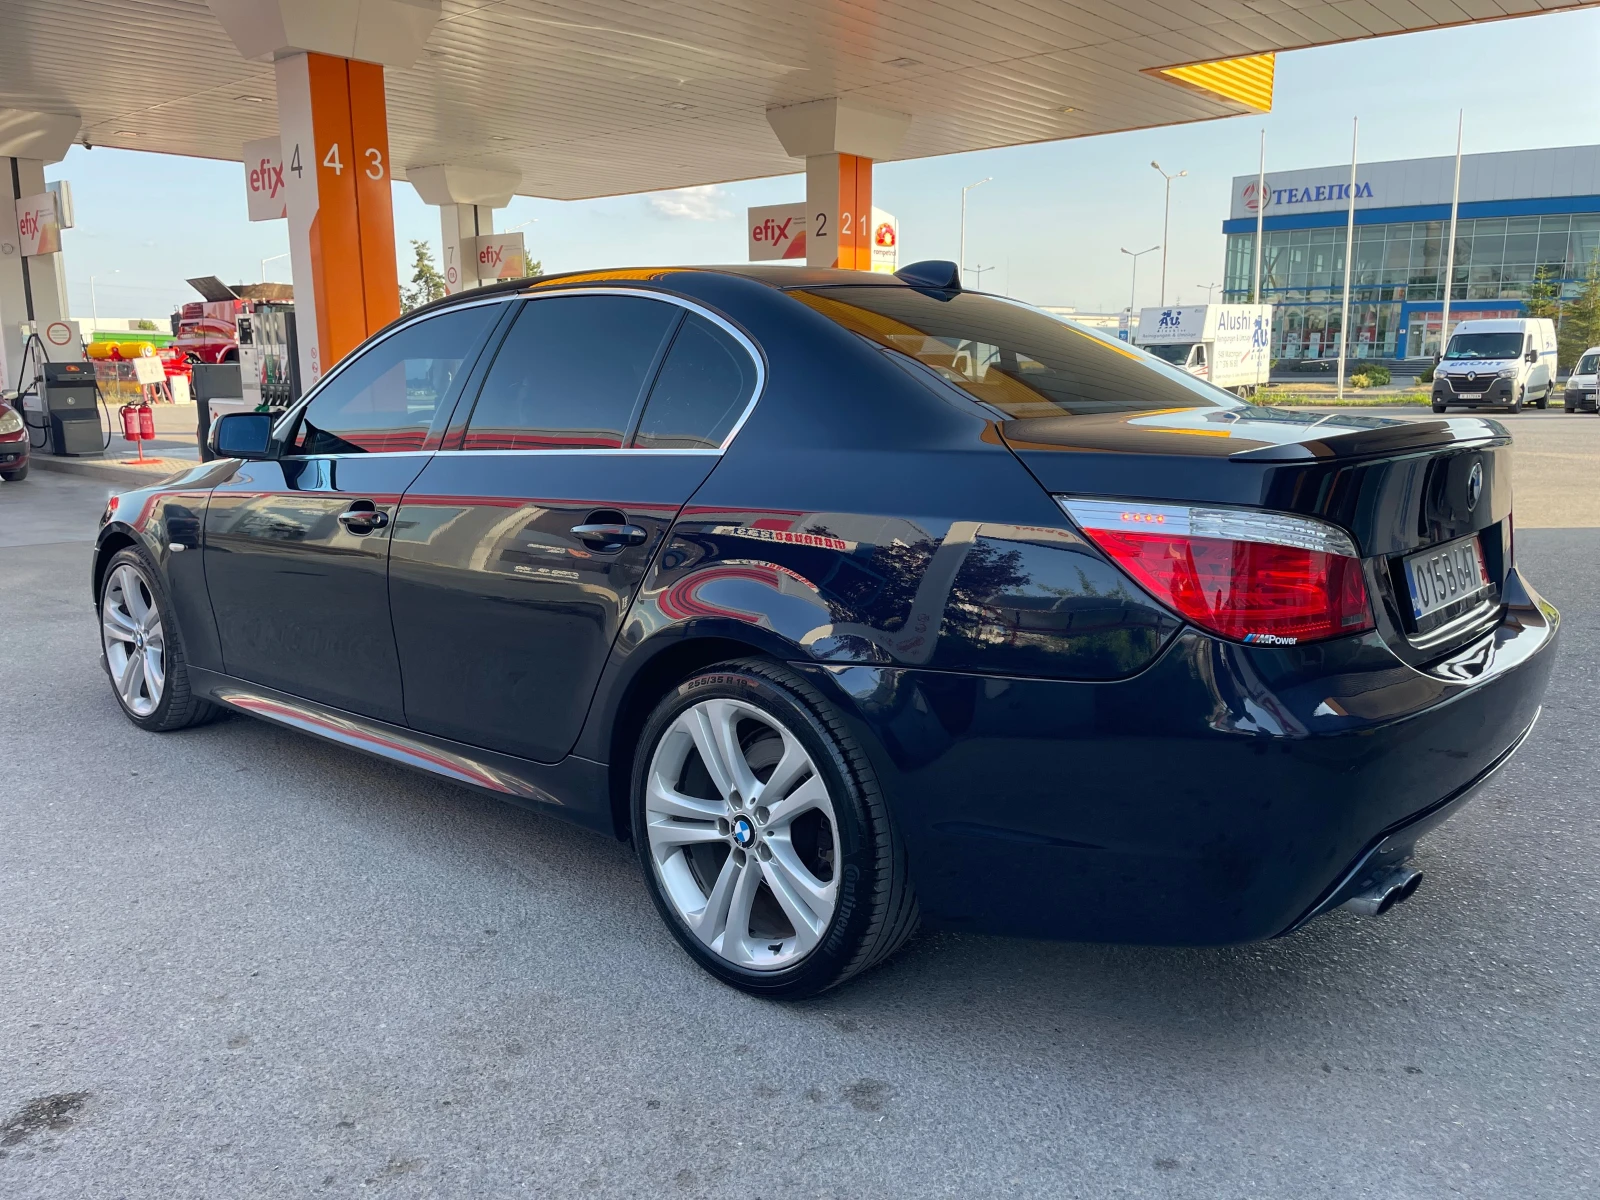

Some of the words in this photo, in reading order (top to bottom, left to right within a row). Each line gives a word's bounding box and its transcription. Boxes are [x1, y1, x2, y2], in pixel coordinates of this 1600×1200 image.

[290, 143, 303, 179] 4
[323, 143, 344, 176] 4
[364, 148, 384, 180] 3
[250, 158, 285, 199] efix
[1272, 182, 1374, 205] ТЕЛЕПОЛ
[20, 209, 39, 240] efix
[752, 217, 793, 246] efix
[815, 212, 827, 237] 2
[841, 212, 852, 235] 2
[860, 214, 866, 236] 1
[447, 246, 455, 264] 7
[479, 245, 504, 268] efix
[1218, 310, 1251, 331] Alushi
[687, 675, 724, 690] 255/35
[726, 676, 734, 685] R
[736, 678, 748, 687] 19
[823, 863, 860, 958] Continental
